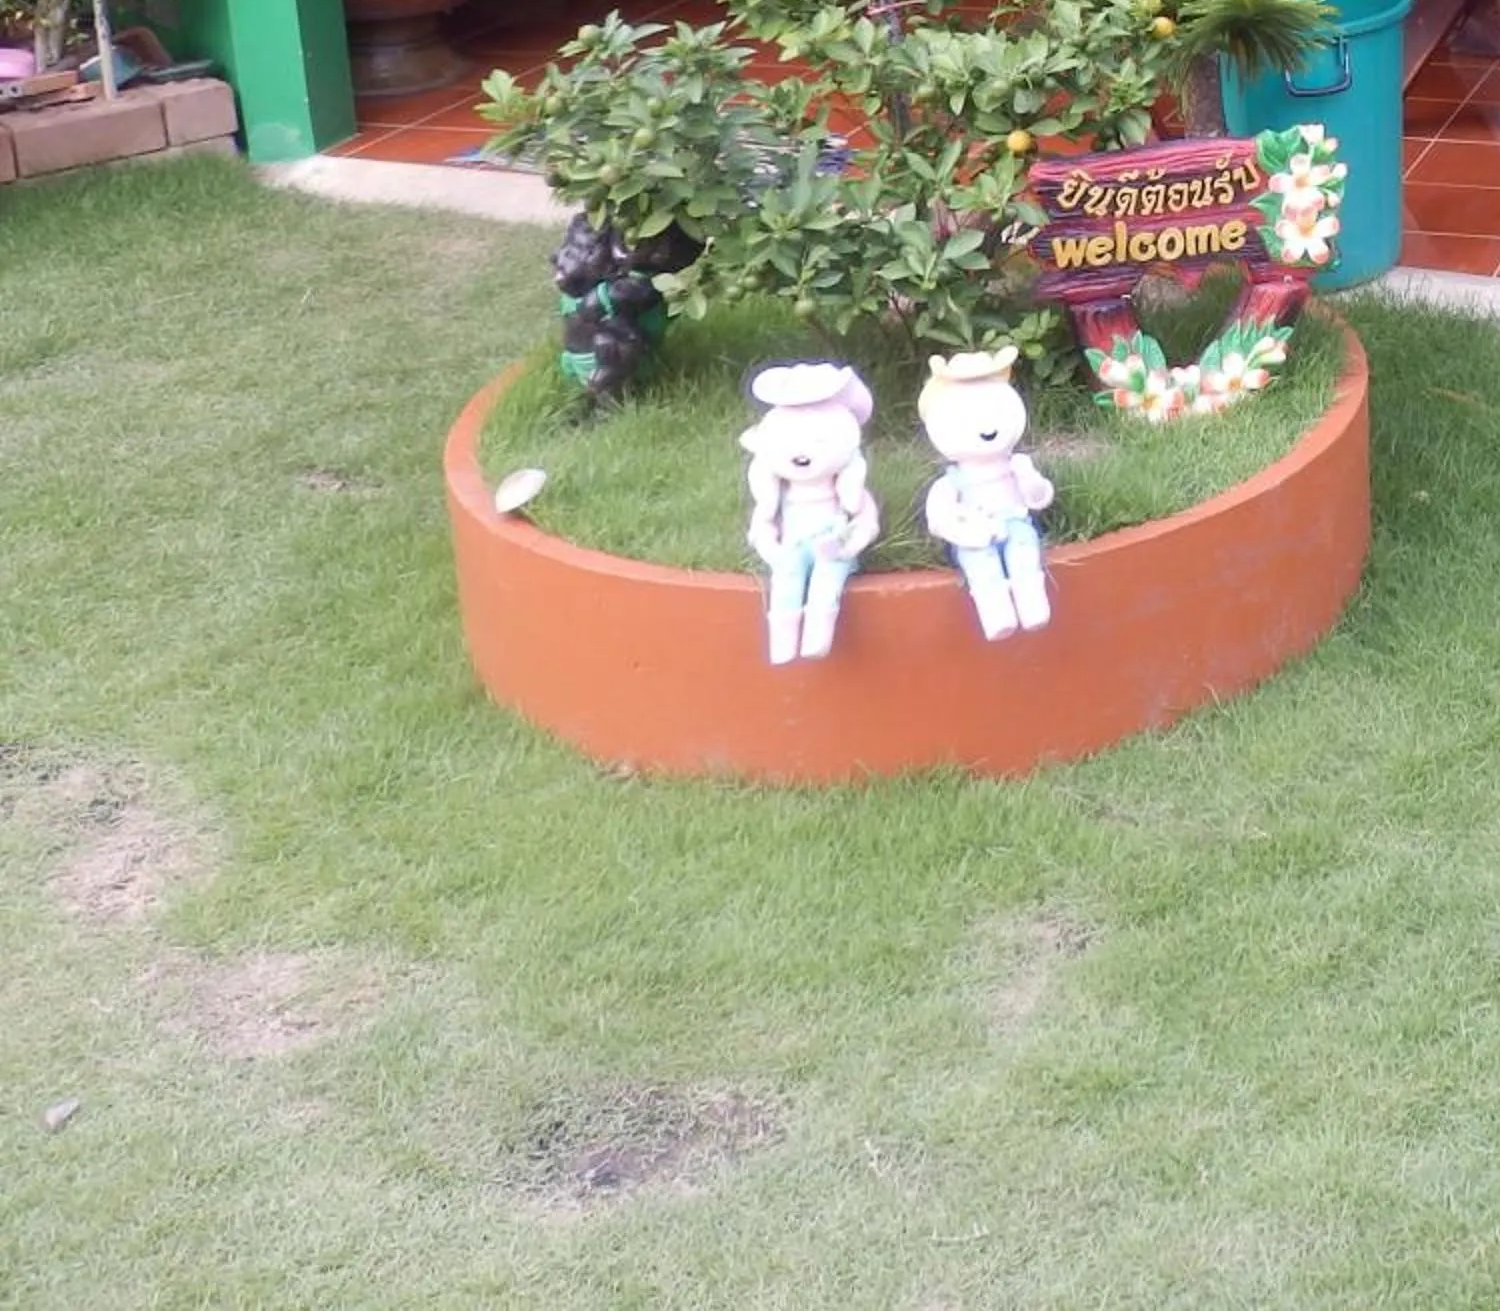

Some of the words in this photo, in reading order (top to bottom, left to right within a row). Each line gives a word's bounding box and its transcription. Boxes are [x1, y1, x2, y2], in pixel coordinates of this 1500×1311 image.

[1056, 152, 1261, 217] ยินดีต้อนรับ
[1052, 219, 1248, 269] welcome
